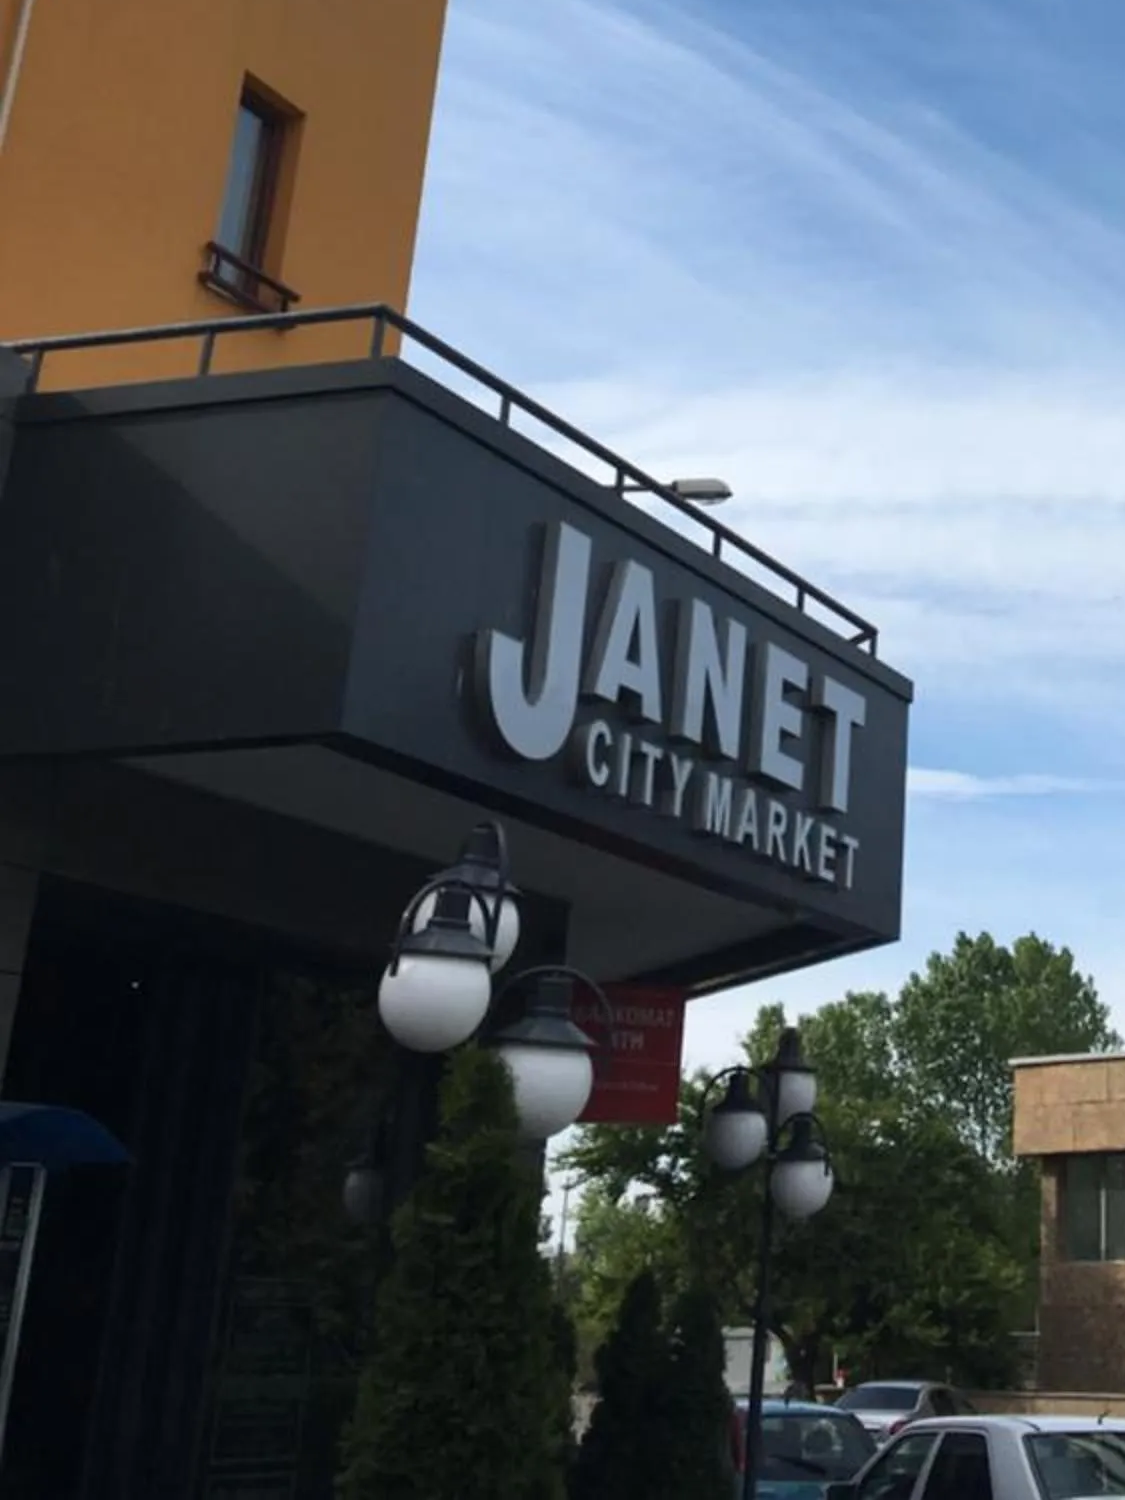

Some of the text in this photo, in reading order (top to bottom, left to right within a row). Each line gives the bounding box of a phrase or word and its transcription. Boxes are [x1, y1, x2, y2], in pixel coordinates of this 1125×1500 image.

[490, 521, 865, 813] JANET
[586, 720, 860, 889] CITY MARKET
